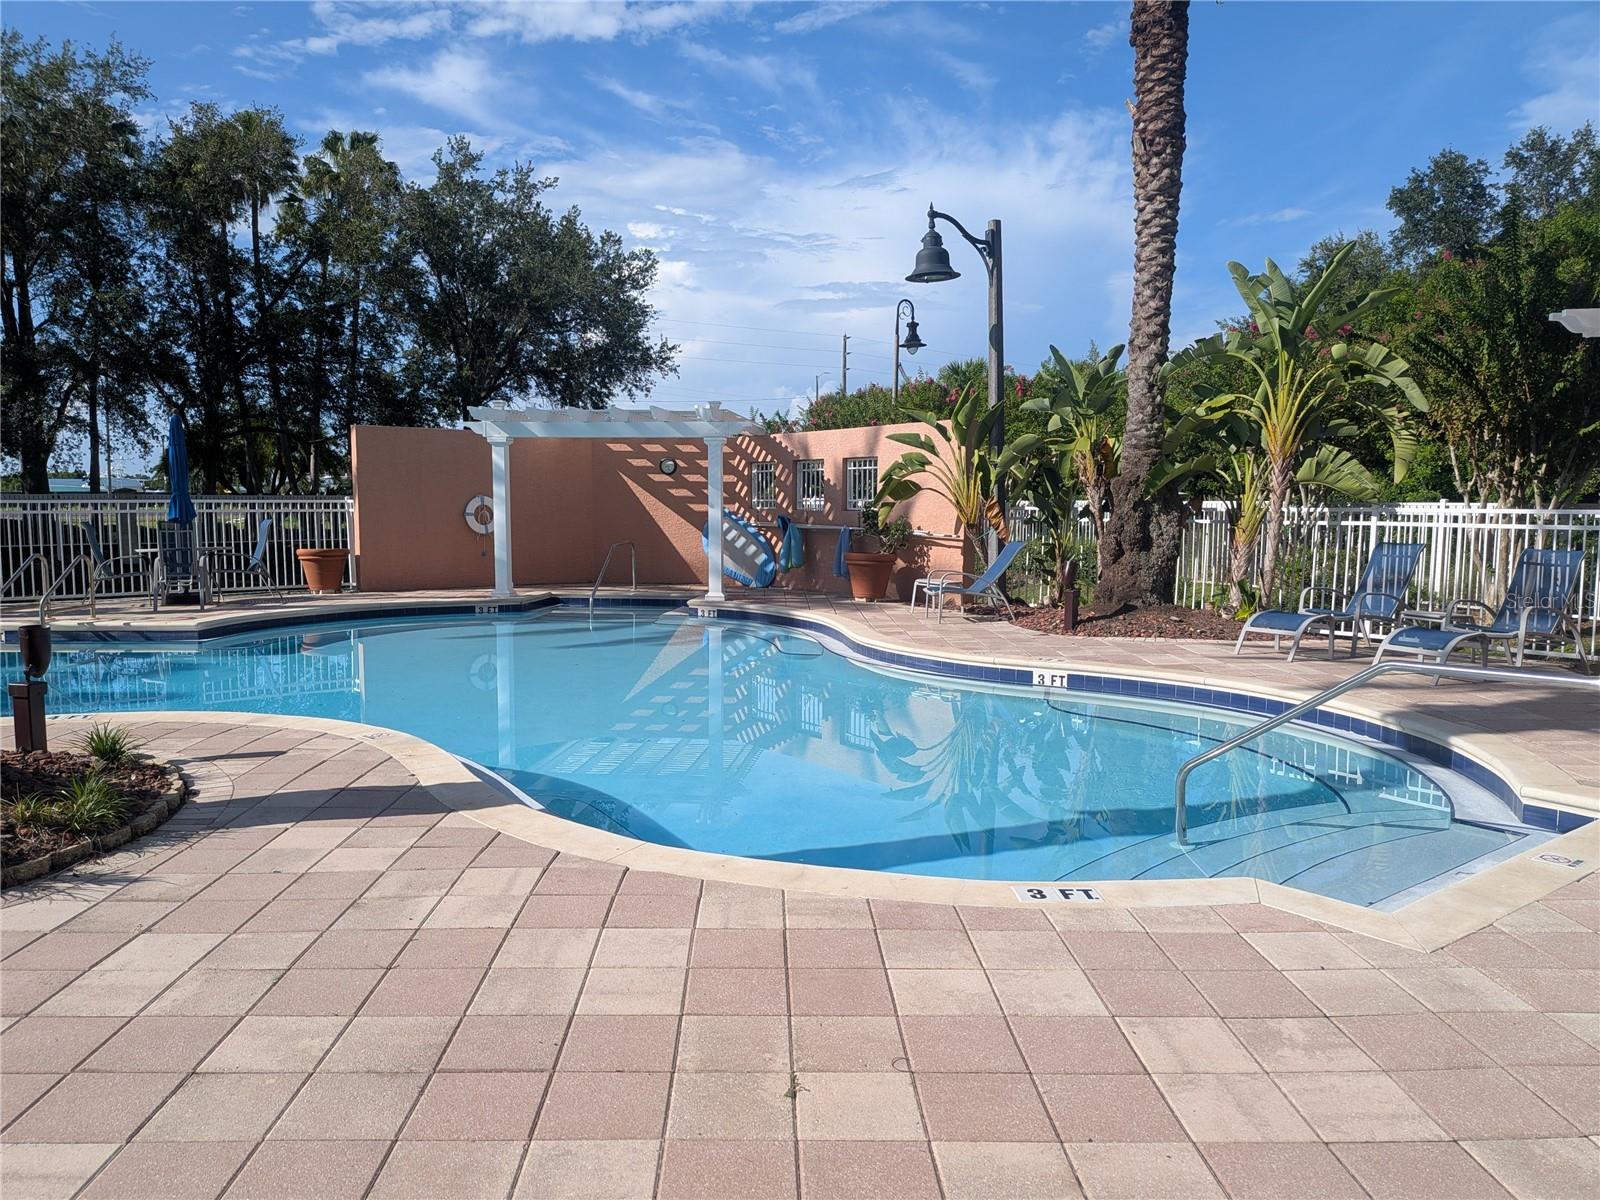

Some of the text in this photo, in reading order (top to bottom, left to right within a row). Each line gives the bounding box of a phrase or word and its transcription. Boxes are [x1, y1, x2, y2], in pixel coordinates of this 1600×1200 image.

[1038, 674, 1045, 685] 3
[1027, 888, 1100, 900] 3 FT.
